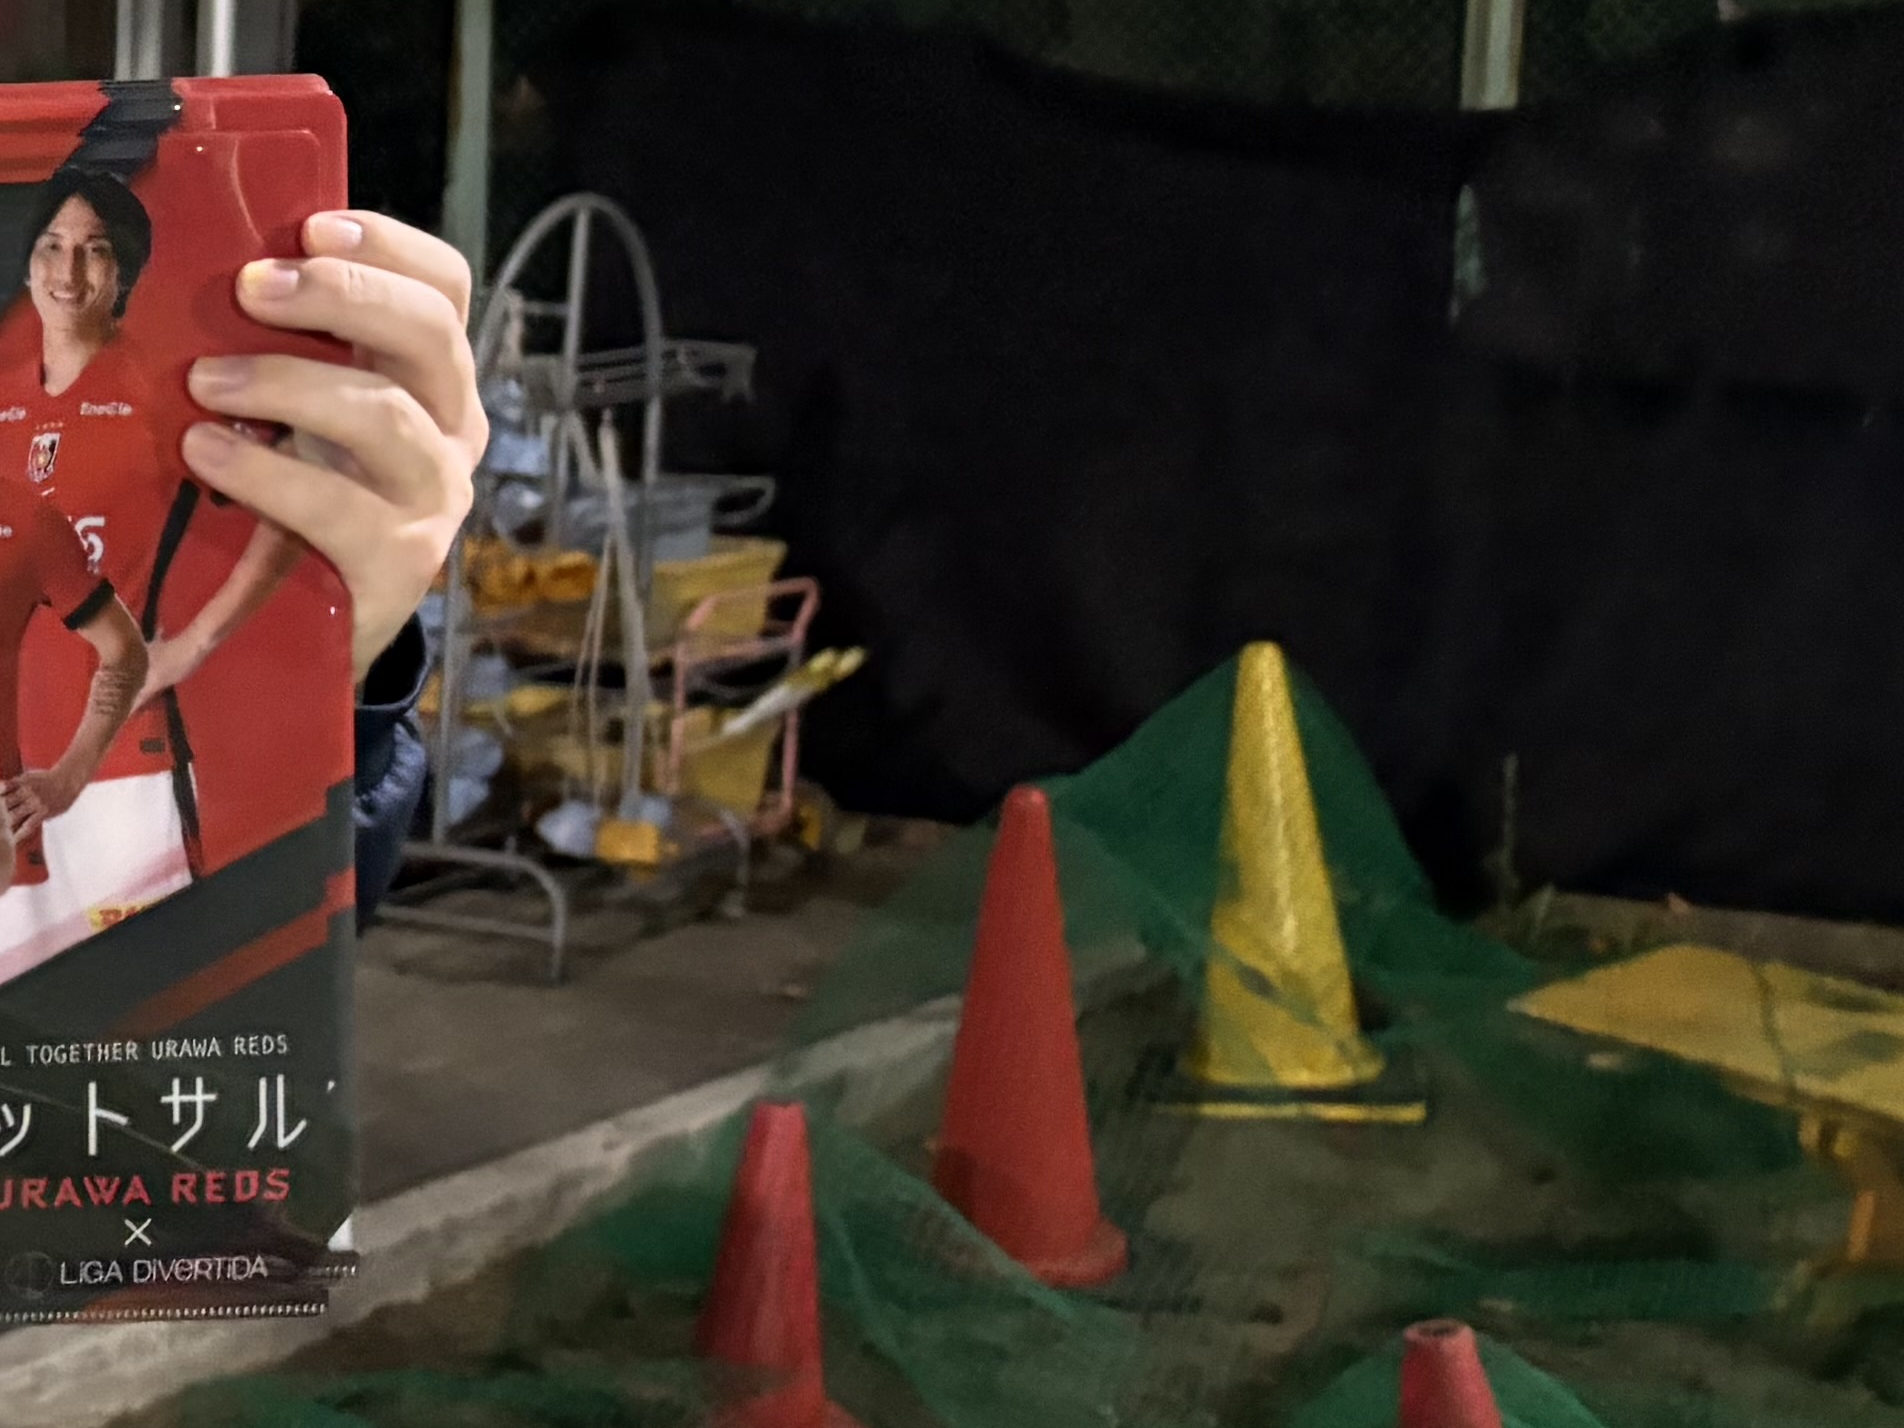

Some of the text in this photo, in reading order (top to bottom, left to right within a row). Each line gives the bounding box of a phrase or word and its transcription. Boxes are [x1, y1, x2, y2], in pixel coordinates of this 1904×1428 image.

[25, 1041, 139, 1066] TOGETHER
[151, 1036, 222, 1059] URAWA
[234, 1033, 289, 1056] REDS
[171, 1167, 291, 1205] REDS
